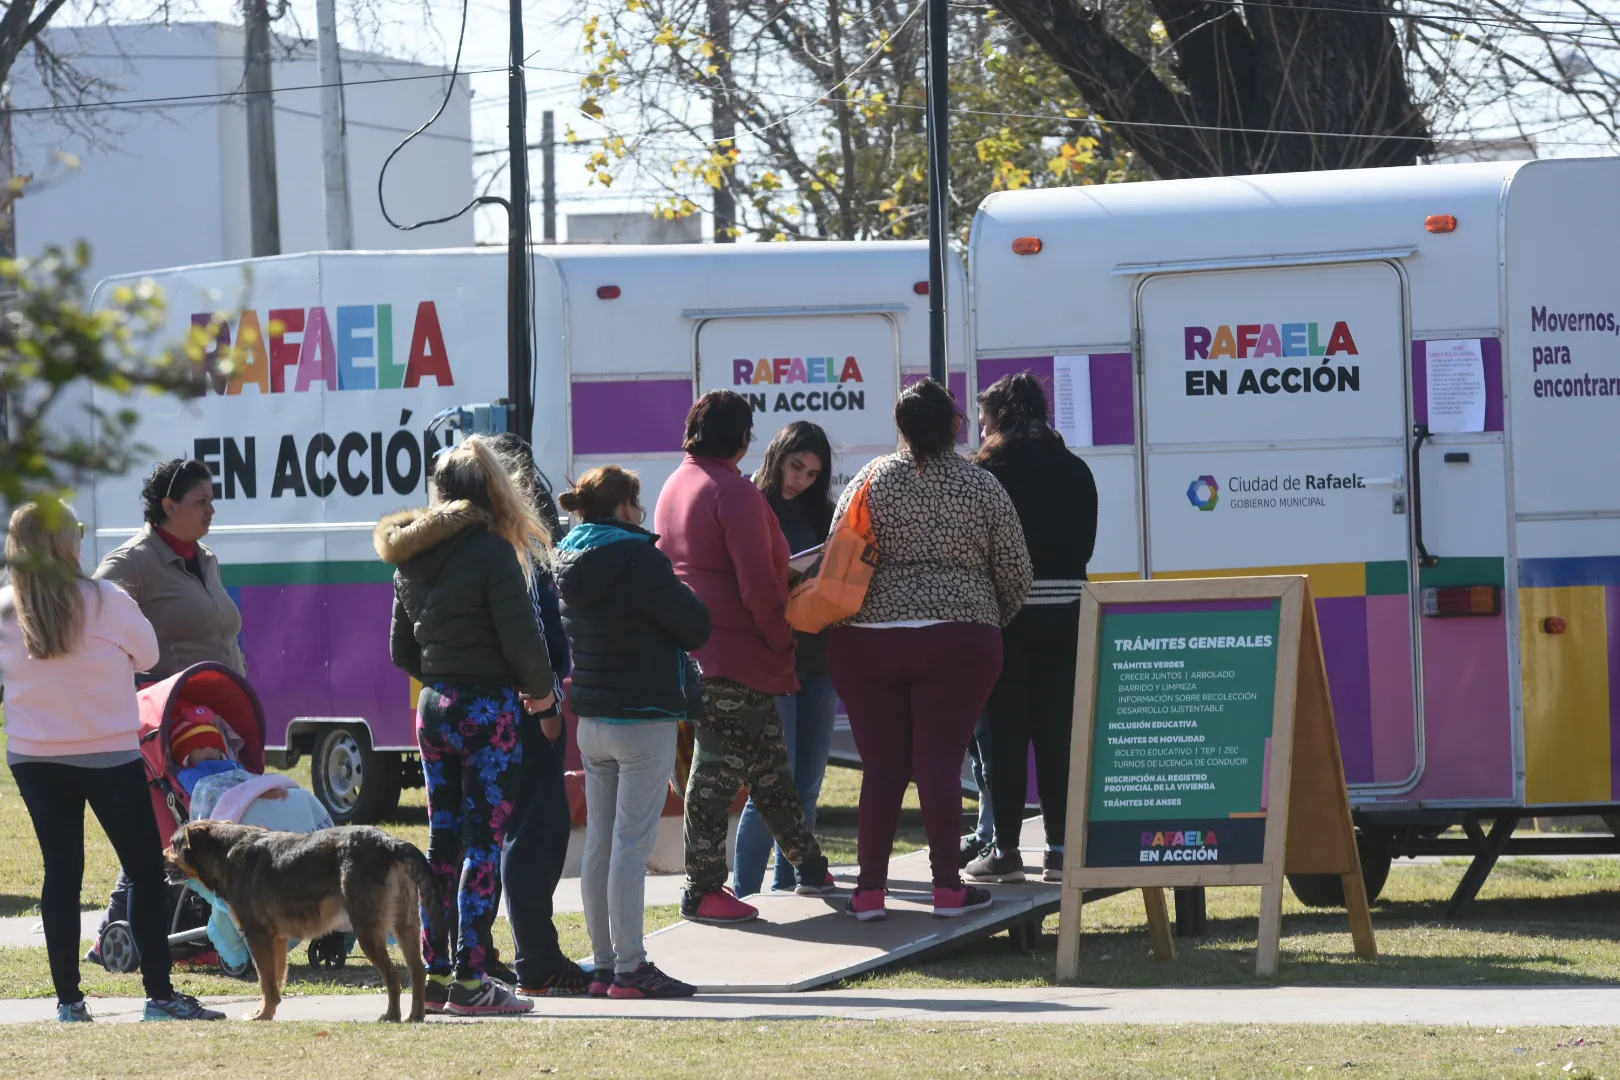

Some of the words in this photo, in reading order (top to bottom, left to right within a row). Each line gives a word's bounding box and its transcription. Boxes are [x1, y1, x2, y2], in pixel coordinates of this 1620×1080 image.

[1531, 305, 1620, 336] Movernos,
[1184, 321, 1359, 360] RAFAELA
[191, 300, 454, 397] RAFAELA
[1532, 345, 1571, 372] para
[733, 356, 864, 385] RAFAELA
[1185, 369, 1228, 396] EN
[1236, 357, 1360, 395] ACCIÓN
[773, 385, 865, 412] ACCIÓN
[194, 436, 257, 500] EN
[1228, 475, 1278, 492] Ciudad
[1283, 475, 1301, 490] de
[1230, 498, 1277, 509] GOBIERNO
[1279, 496, 1326, 508] MUNICIPAL
[1114, 636, 1186, 651] TRÁMITES
[1188, 635, 1273, 649] GENERALES
[1112, 661, 1152, 670] TRÁMITES
[1153, 660, 1185, 669] VERDES
[1120, 673, 1150, 681] CRECER
[1150, 672, 1182, 680] JUNTOS
[1191, 670, 1235, 679] ARBOLADO
[1118, 684, 1154, 692] BARRIDO
[1155, 684, 1161, 692] Y
[1161, 682, 1197, 691] LIMPIEZA
[1118, 693, 1174, 703] INFORMACIÓN
[1174, 693, 1201, 702] SOBRE
[1202, 690, 1257, 701] RECOLECCIÓN
[1117, 705, 1169, 715] DESARROLLO
[1169, 704, 1225, 714] SUSTENTABLE
[1108, 720, 1151, 730] INCLUSIÓN
[1151, 720, 1198, 729] EDUCATIVA
[1107, 736, 1147, 745] TRÁMITES
[1148, 736, 1159, 744] DE
[1160, 735, 1205, 743] MOVILIDAD
[1115, 748, 1147, 757] BOLETO
[1147, 747, 1192, 756] EDUCATIVO
[1200, 747, 1216, 755] TEP
[1223, 746, 1239, 755] ZEC
[1113, 760, 1146, 768] TURNOS
[1146, 760, 1157, 768] DE
[1158, 758, 1194, 767] LICENCIA
[1194, 758, 1205, 766] DE
[1206, 757, 1248, 766] CONDUCIR
[1104, 773, 1155, 784] INSCRIPCIÓN
[1156, 774, 1167, 782] AL
[1167, 773, 1208, 782] REGISTRO
[1104, 784, 1153, 792] PROVINCIAL
[1153, 783, 1165, 792] DE
[1165, 783, 1176, 791] LA
[1176, 782, 1216, 791] VIVIENDA
[1103, 798, 1143, 808] TRÁMITES
[1143, 799, 1155, 807] DE
[1155, 798, 1182, 806] ANSES
[1141, 830, 1218, 847] RAFAELA
[1139, 849, 1160, 862] EN
[1162, 846, 1218, 861] ACCIÓN
